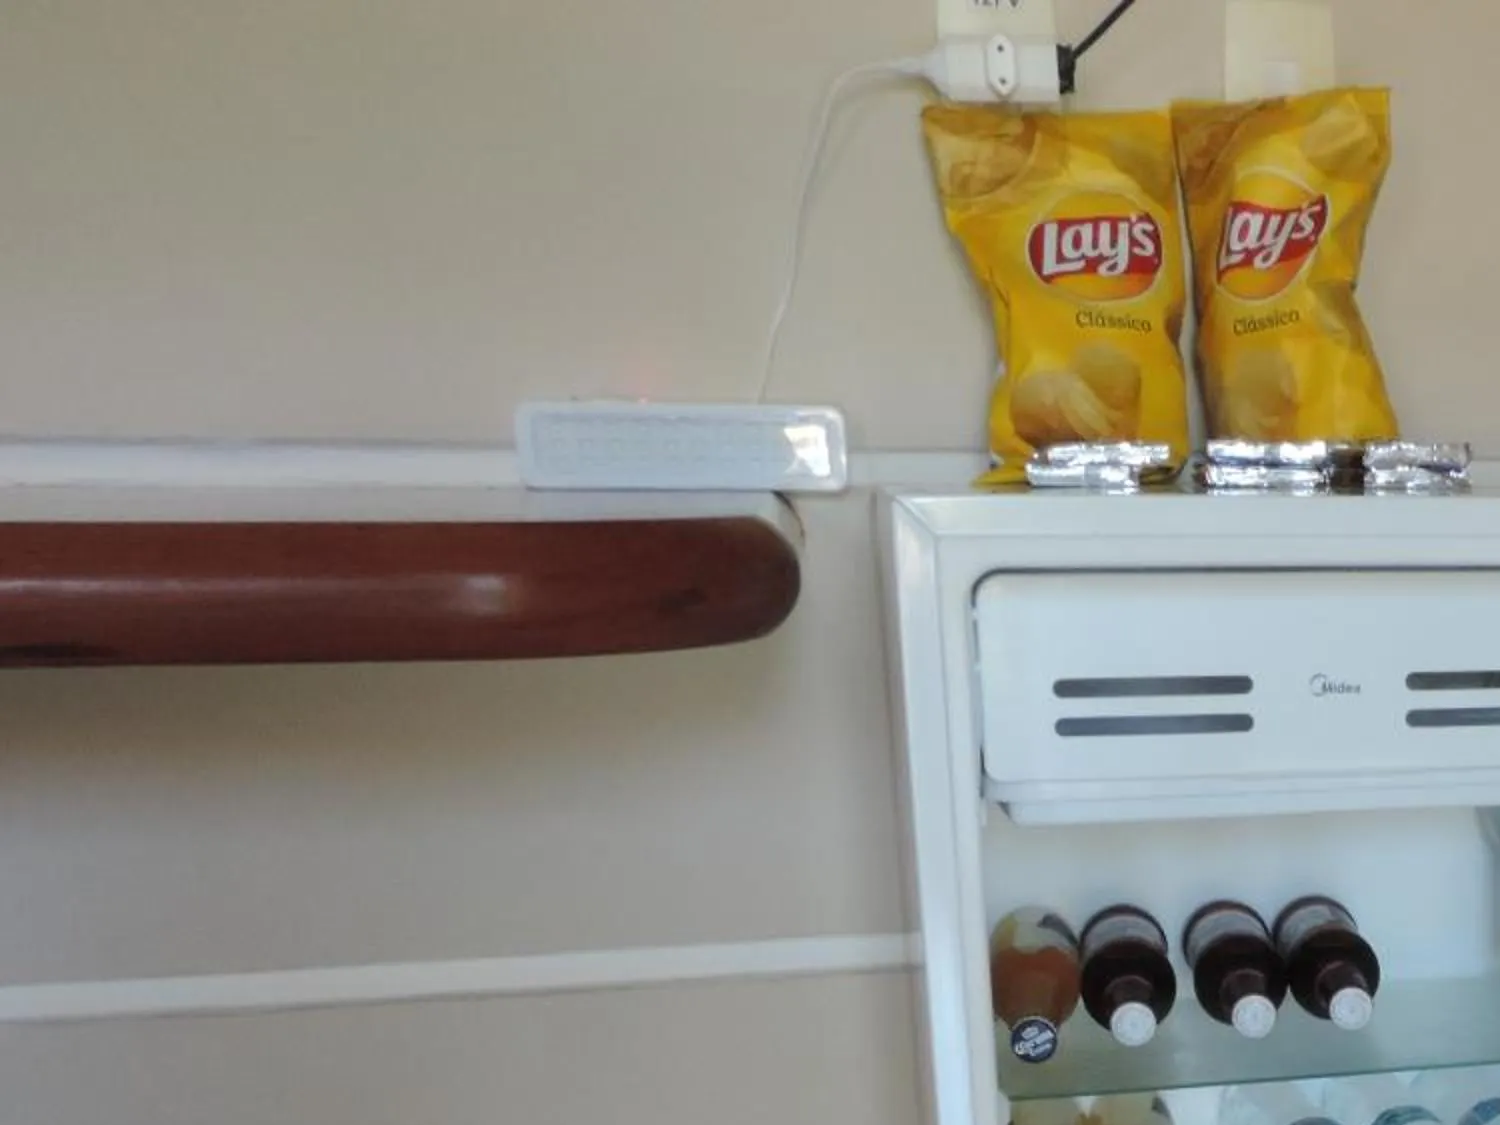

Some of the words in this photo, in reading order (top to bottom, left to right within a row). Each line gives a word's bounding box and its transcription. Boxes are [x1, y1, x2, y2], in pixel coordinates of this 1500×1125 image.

[1042, 212, 1155, 276] Lay's
[1219, 200, 1321, 270] Lay's
[1075, 309, 1152, 333] Clássico
